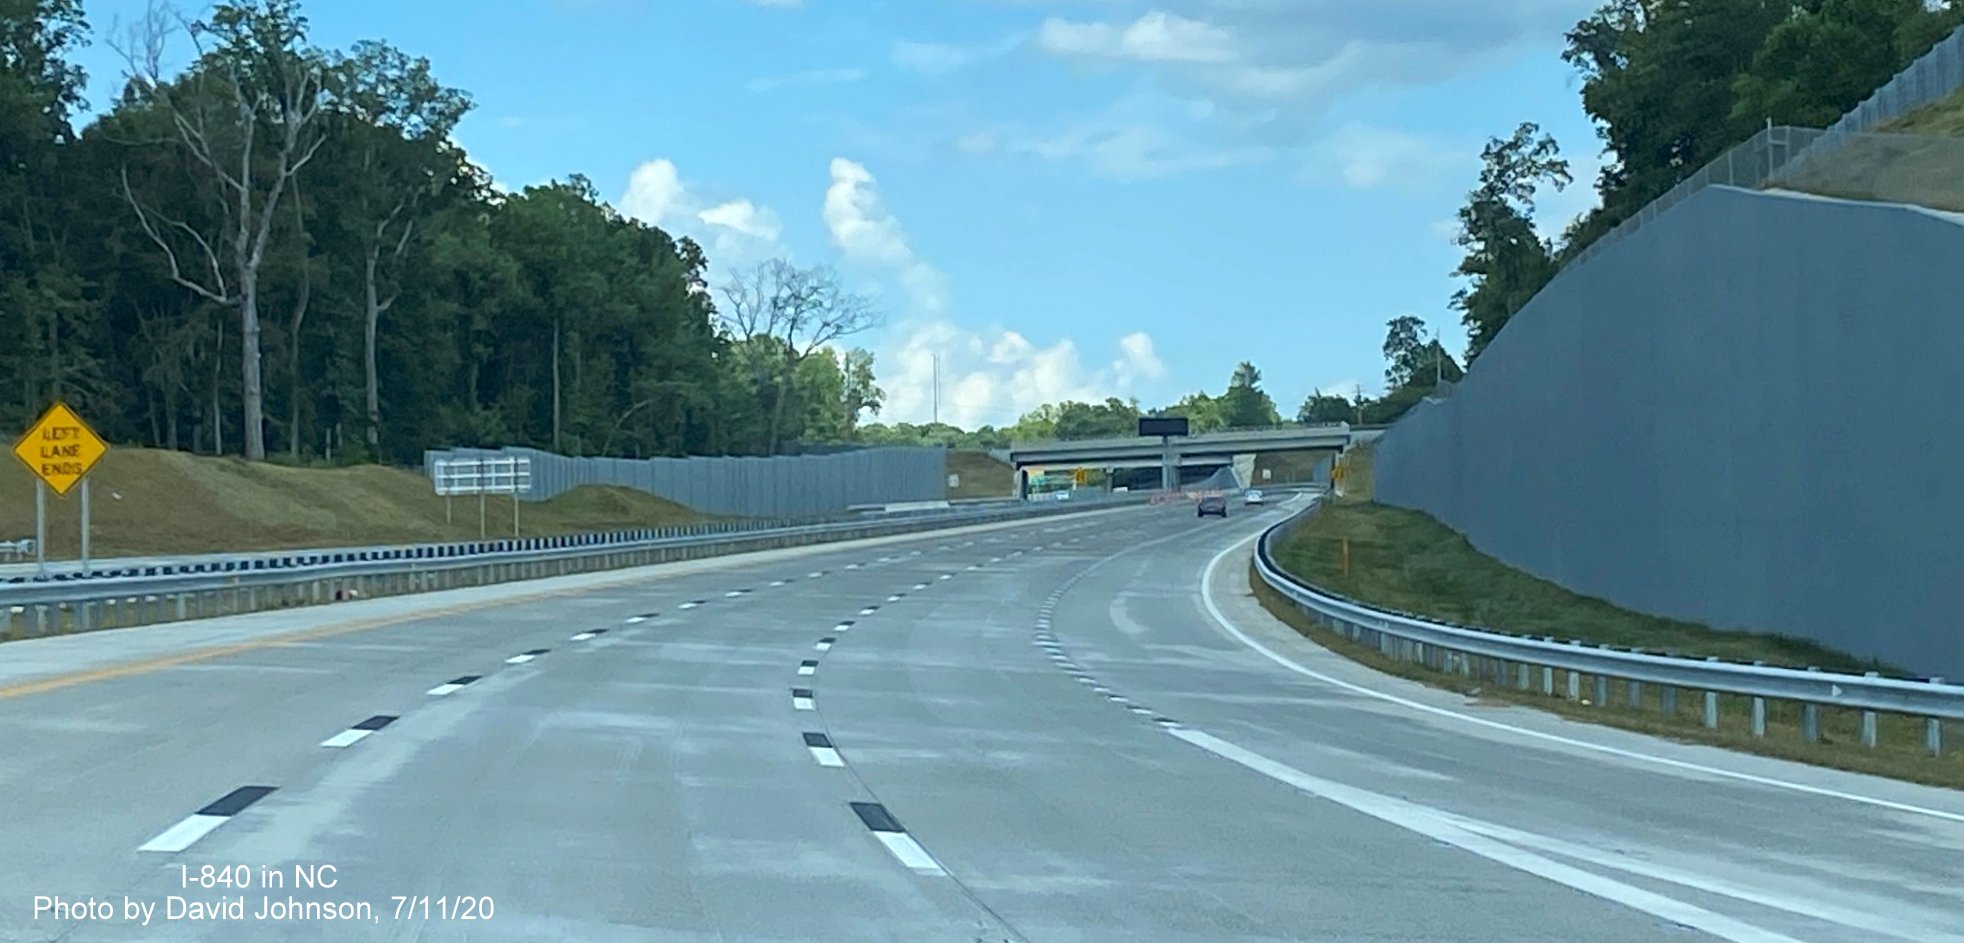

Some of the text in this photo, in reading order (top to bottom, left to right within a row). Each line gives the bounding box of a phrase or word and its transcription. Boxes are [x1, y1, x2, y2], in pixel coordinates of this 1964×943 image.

[42, 426, 81, 441] LEFT
[41, 444, 80, 458] LANE
[41, 461, 82, 477] ENDS
